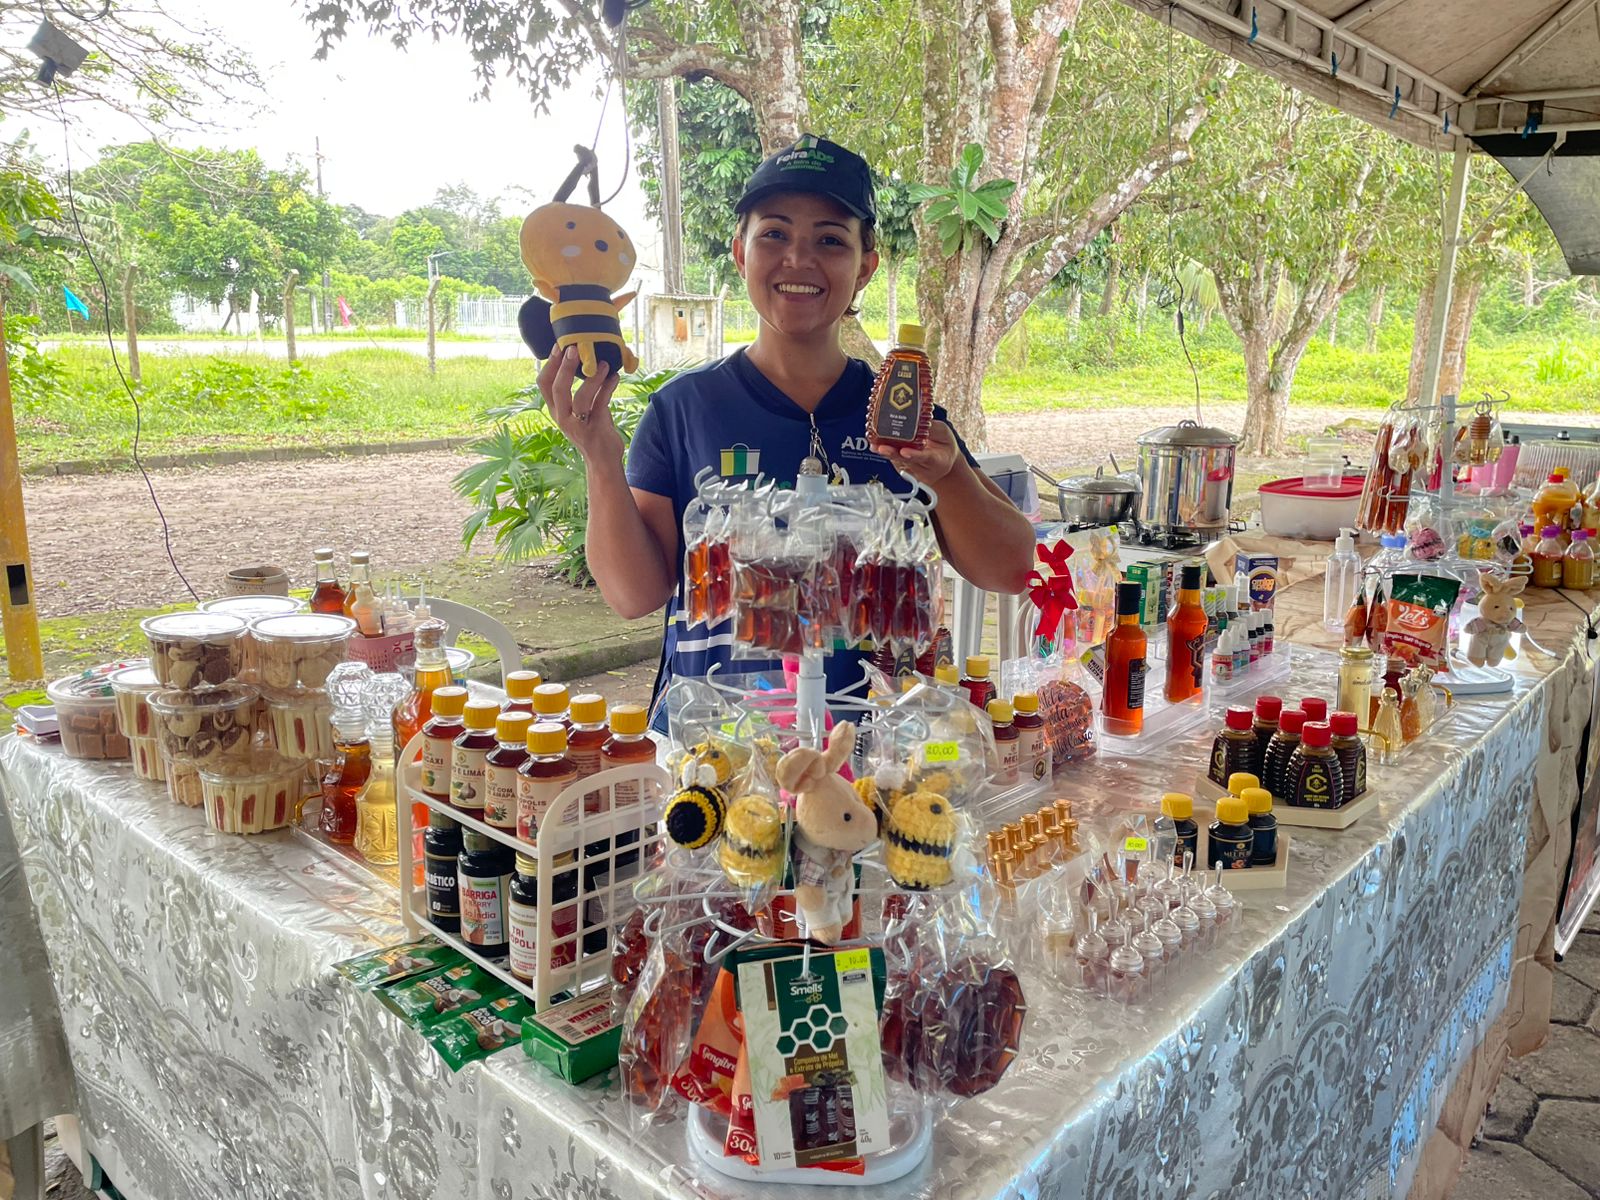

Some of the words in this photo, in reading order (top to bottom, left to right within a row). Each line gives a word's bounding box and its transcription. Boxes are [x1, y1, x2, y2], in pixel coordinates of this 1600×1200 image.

[841, 435, 868, 451] AD
[1398, 604, 1428, 625] Let's
[512, 925, 524, 938] TRI
[790, 983, 823, 996] Smells
[773, 1152, 781, 1160] 10
